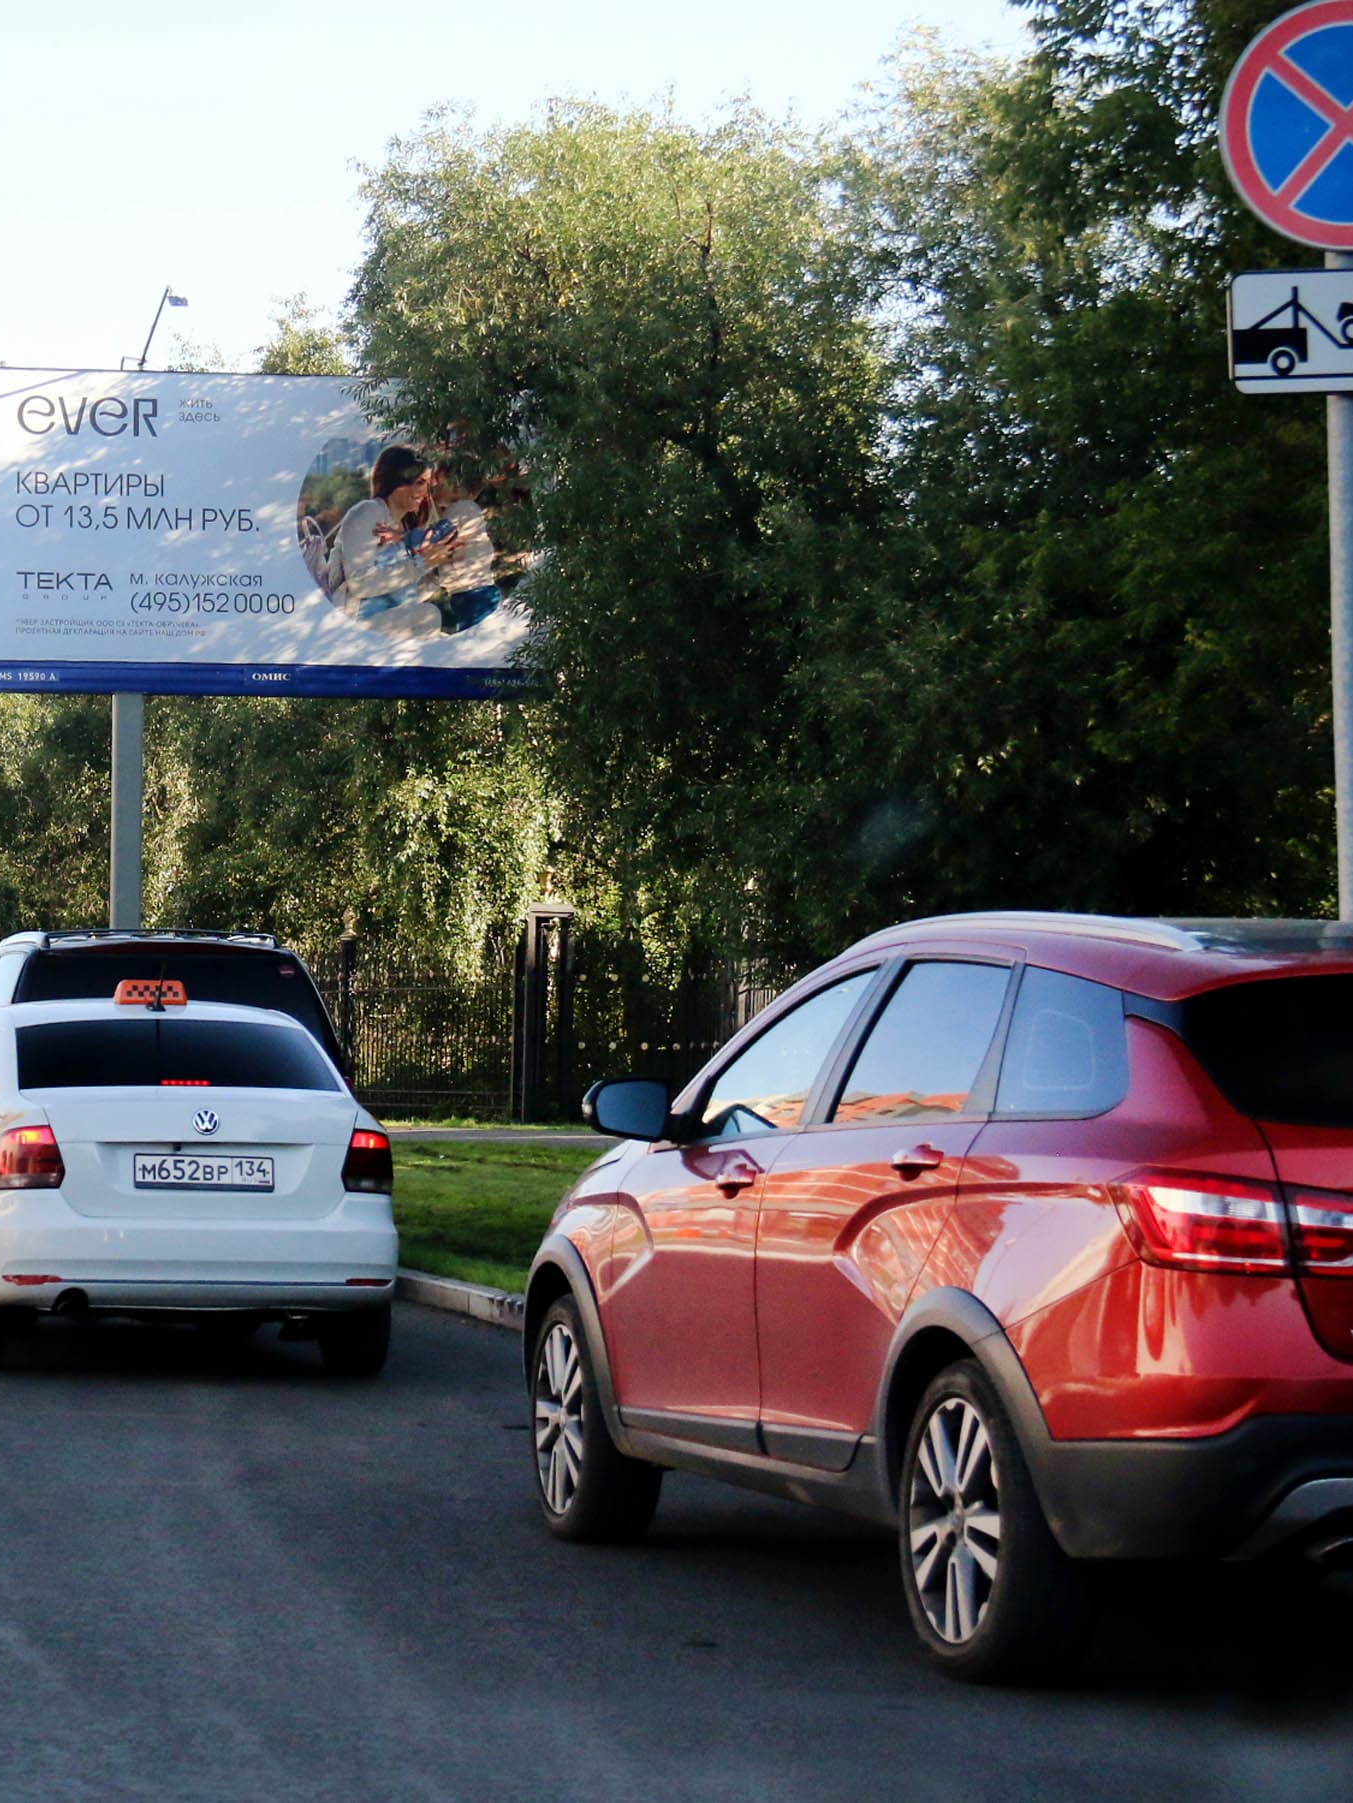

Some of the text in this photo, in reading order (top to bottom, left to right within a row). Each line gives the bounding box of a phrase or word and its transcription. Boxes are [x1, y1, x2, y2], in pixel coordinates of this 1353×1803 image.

[16, 471, 165, 498] КВАРТИРЫ
[15, 504, 260, 532] ОТ 13,5 МЛН РУБ.
[15, 571, 114, 592] ТЕКТА
